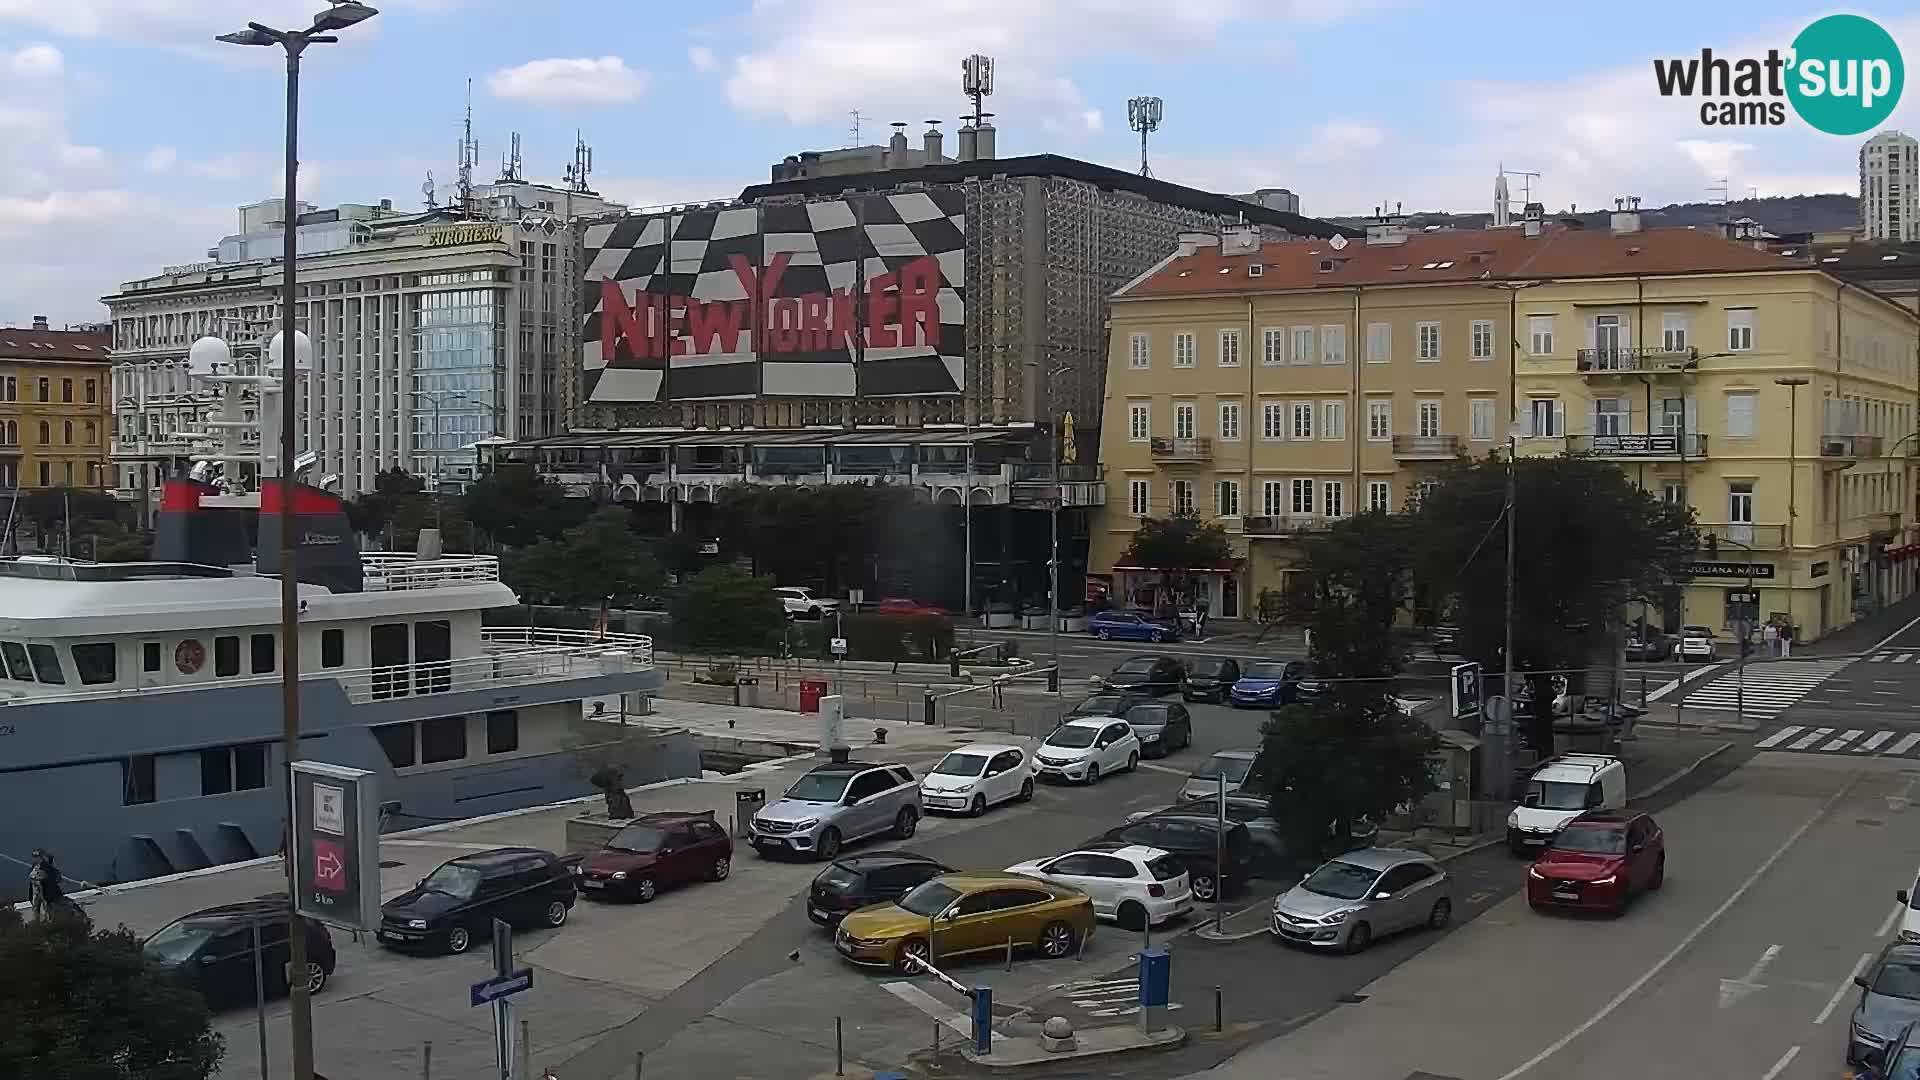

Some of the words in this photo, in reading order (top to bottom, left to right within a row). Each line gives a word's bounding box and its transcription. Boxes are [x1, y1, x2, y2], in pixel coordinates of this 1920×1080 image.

[429, 226, 503, 247] EUROHERC
[1687, 566, 1733, 575] JULIANA
[1737, 566, 1769, 576] NAILS
[1463, 670, 1475, 694] P
